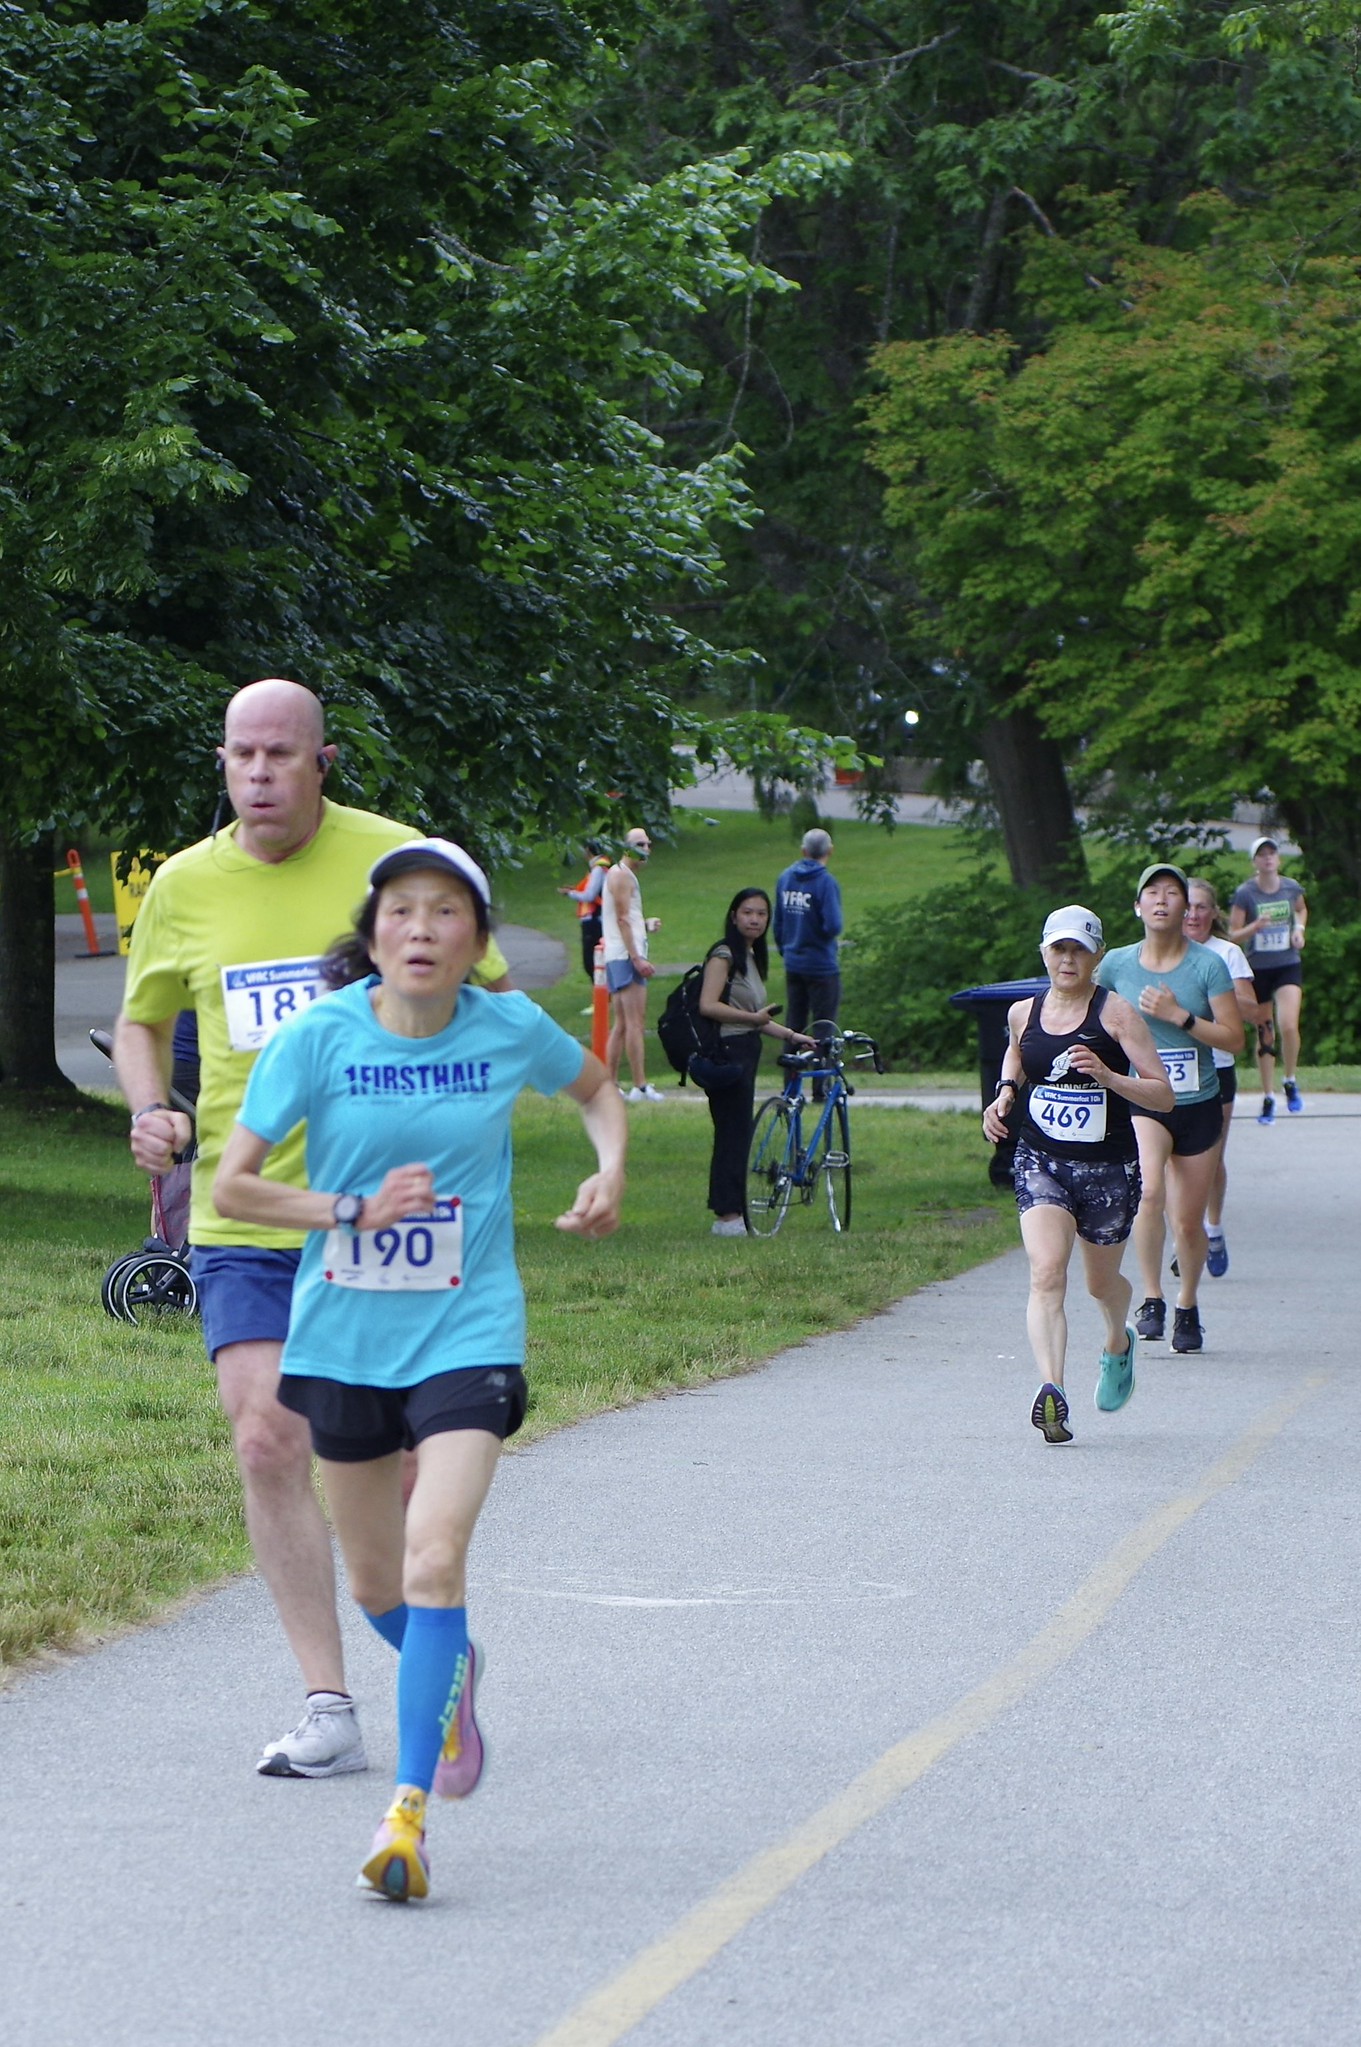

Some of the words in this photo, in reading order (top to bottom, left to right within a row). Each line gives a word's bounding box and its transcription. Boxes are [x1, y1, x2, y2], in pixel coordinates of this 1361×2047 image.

[783, 891, 812, 908] VFAC
[1041, 1104, 1091, 1129] 469
[352, 1227, 433, 1268] 190
